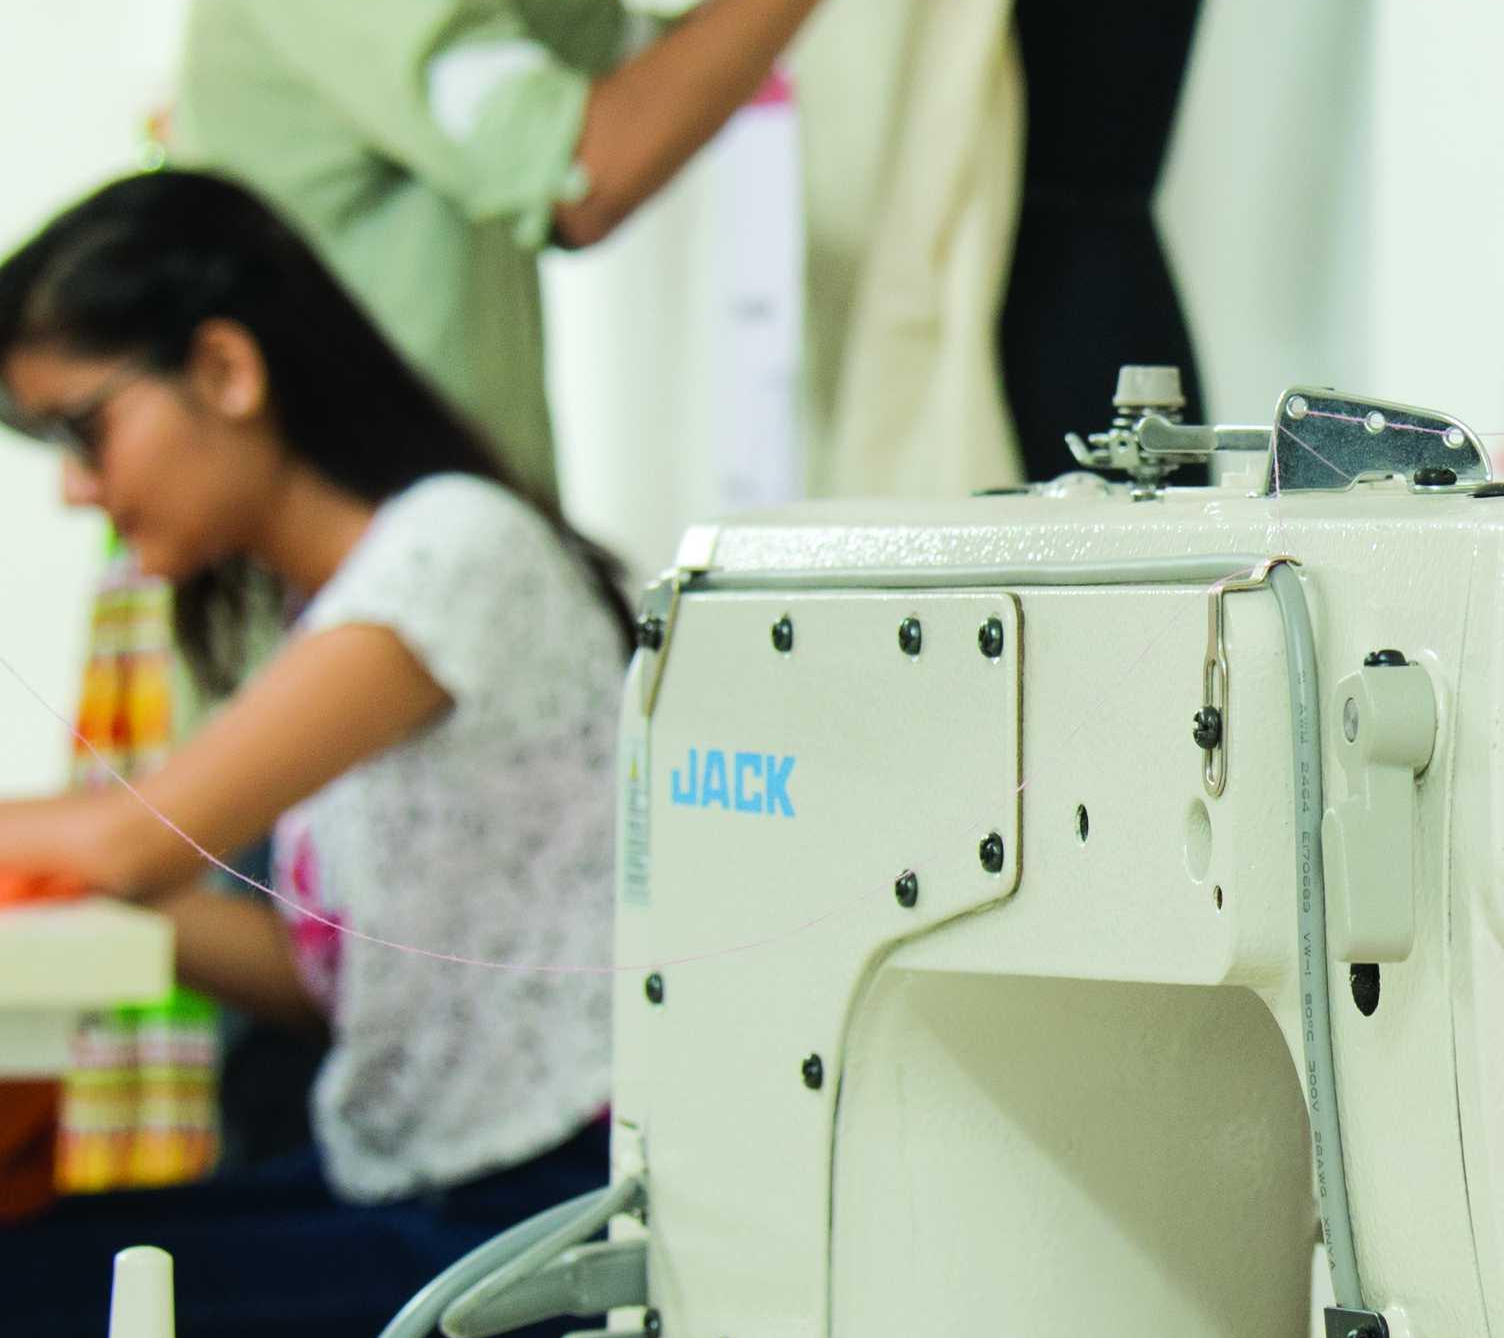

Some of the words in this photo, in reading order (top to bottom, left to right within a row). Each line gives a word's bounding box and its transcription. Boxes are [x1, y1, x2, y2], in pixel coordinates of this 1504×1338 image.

[672, 747, 796, 819] JACK
[1303, 932, 1313, 976] VW-1
[1308, 1060, 1320, 1112] 300V
